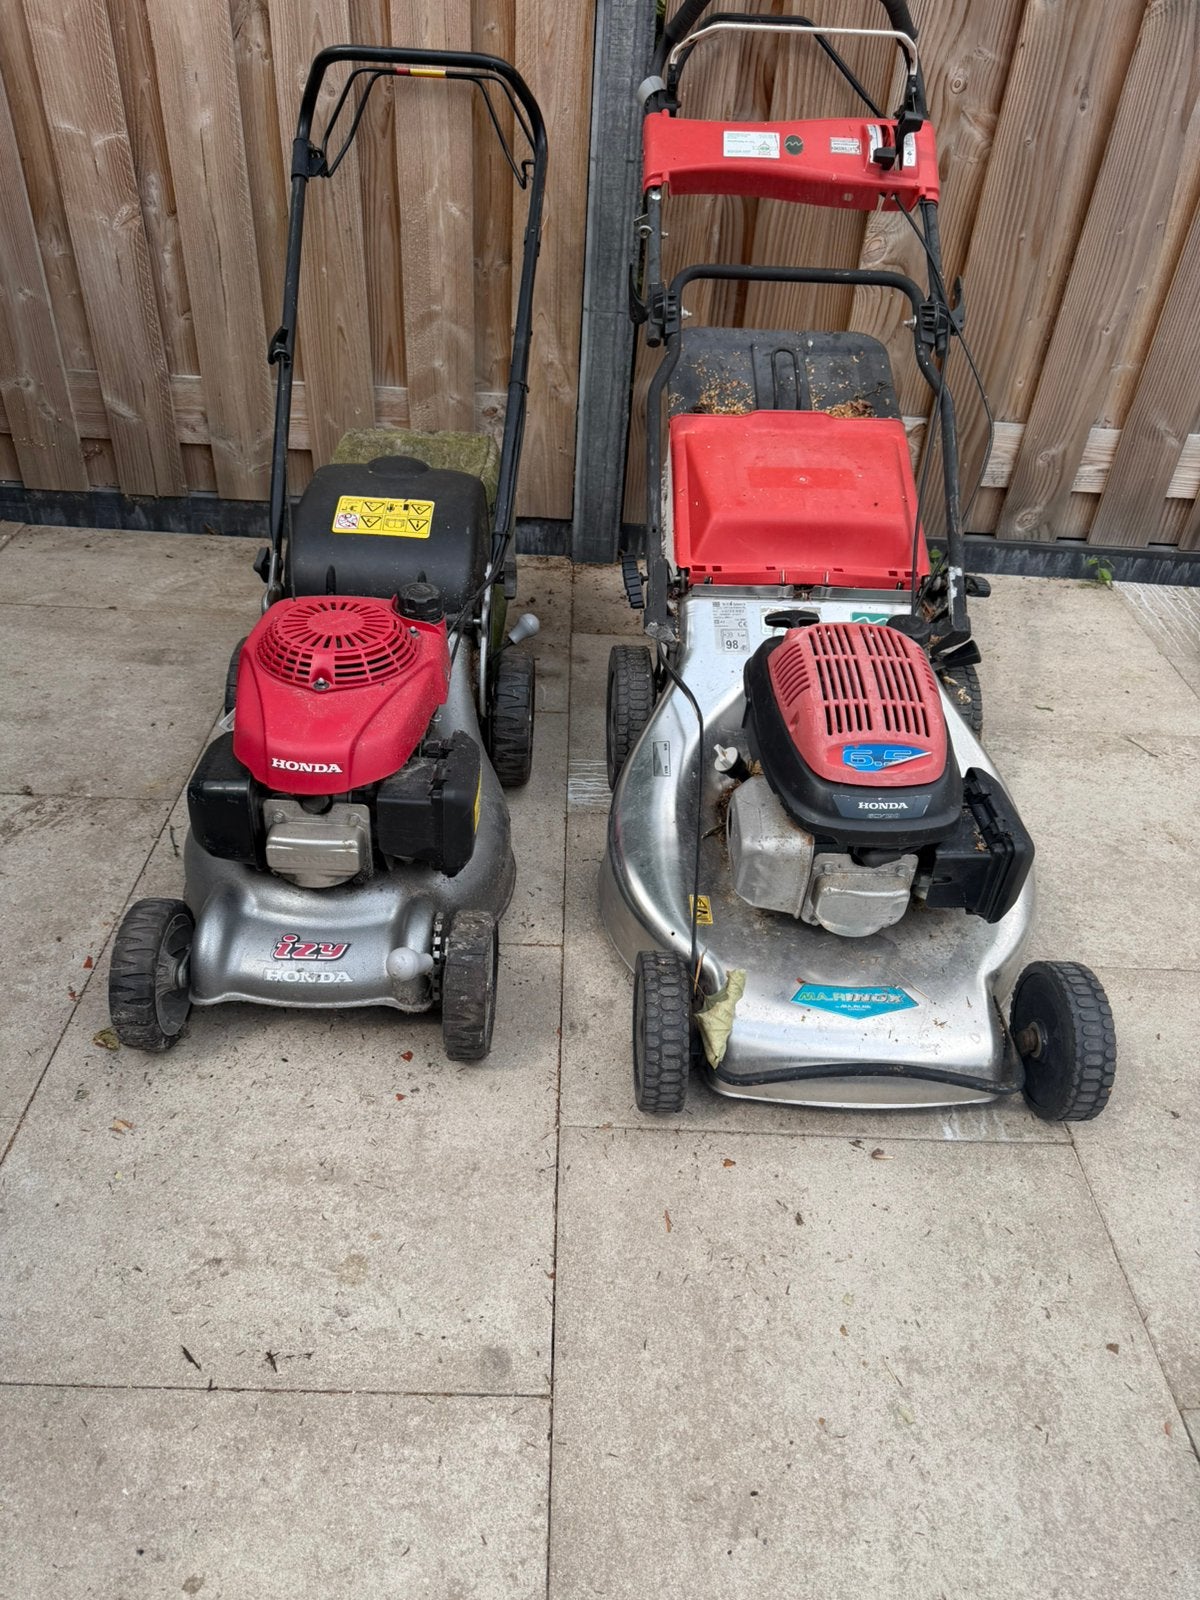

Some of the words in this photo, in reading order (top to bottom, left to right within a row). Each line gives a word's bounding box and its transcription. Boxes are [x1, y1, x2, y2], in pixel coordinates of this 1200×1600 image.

[726, 640, 739, 649] 98
[271, 757, 343, 773] HONDA
[843, 749, 912, 767] 6.5
[858, 801, 908, 810] HONDA
[273, 933, 351, 961] izy
[264, 968, 353, 983] HONDA
